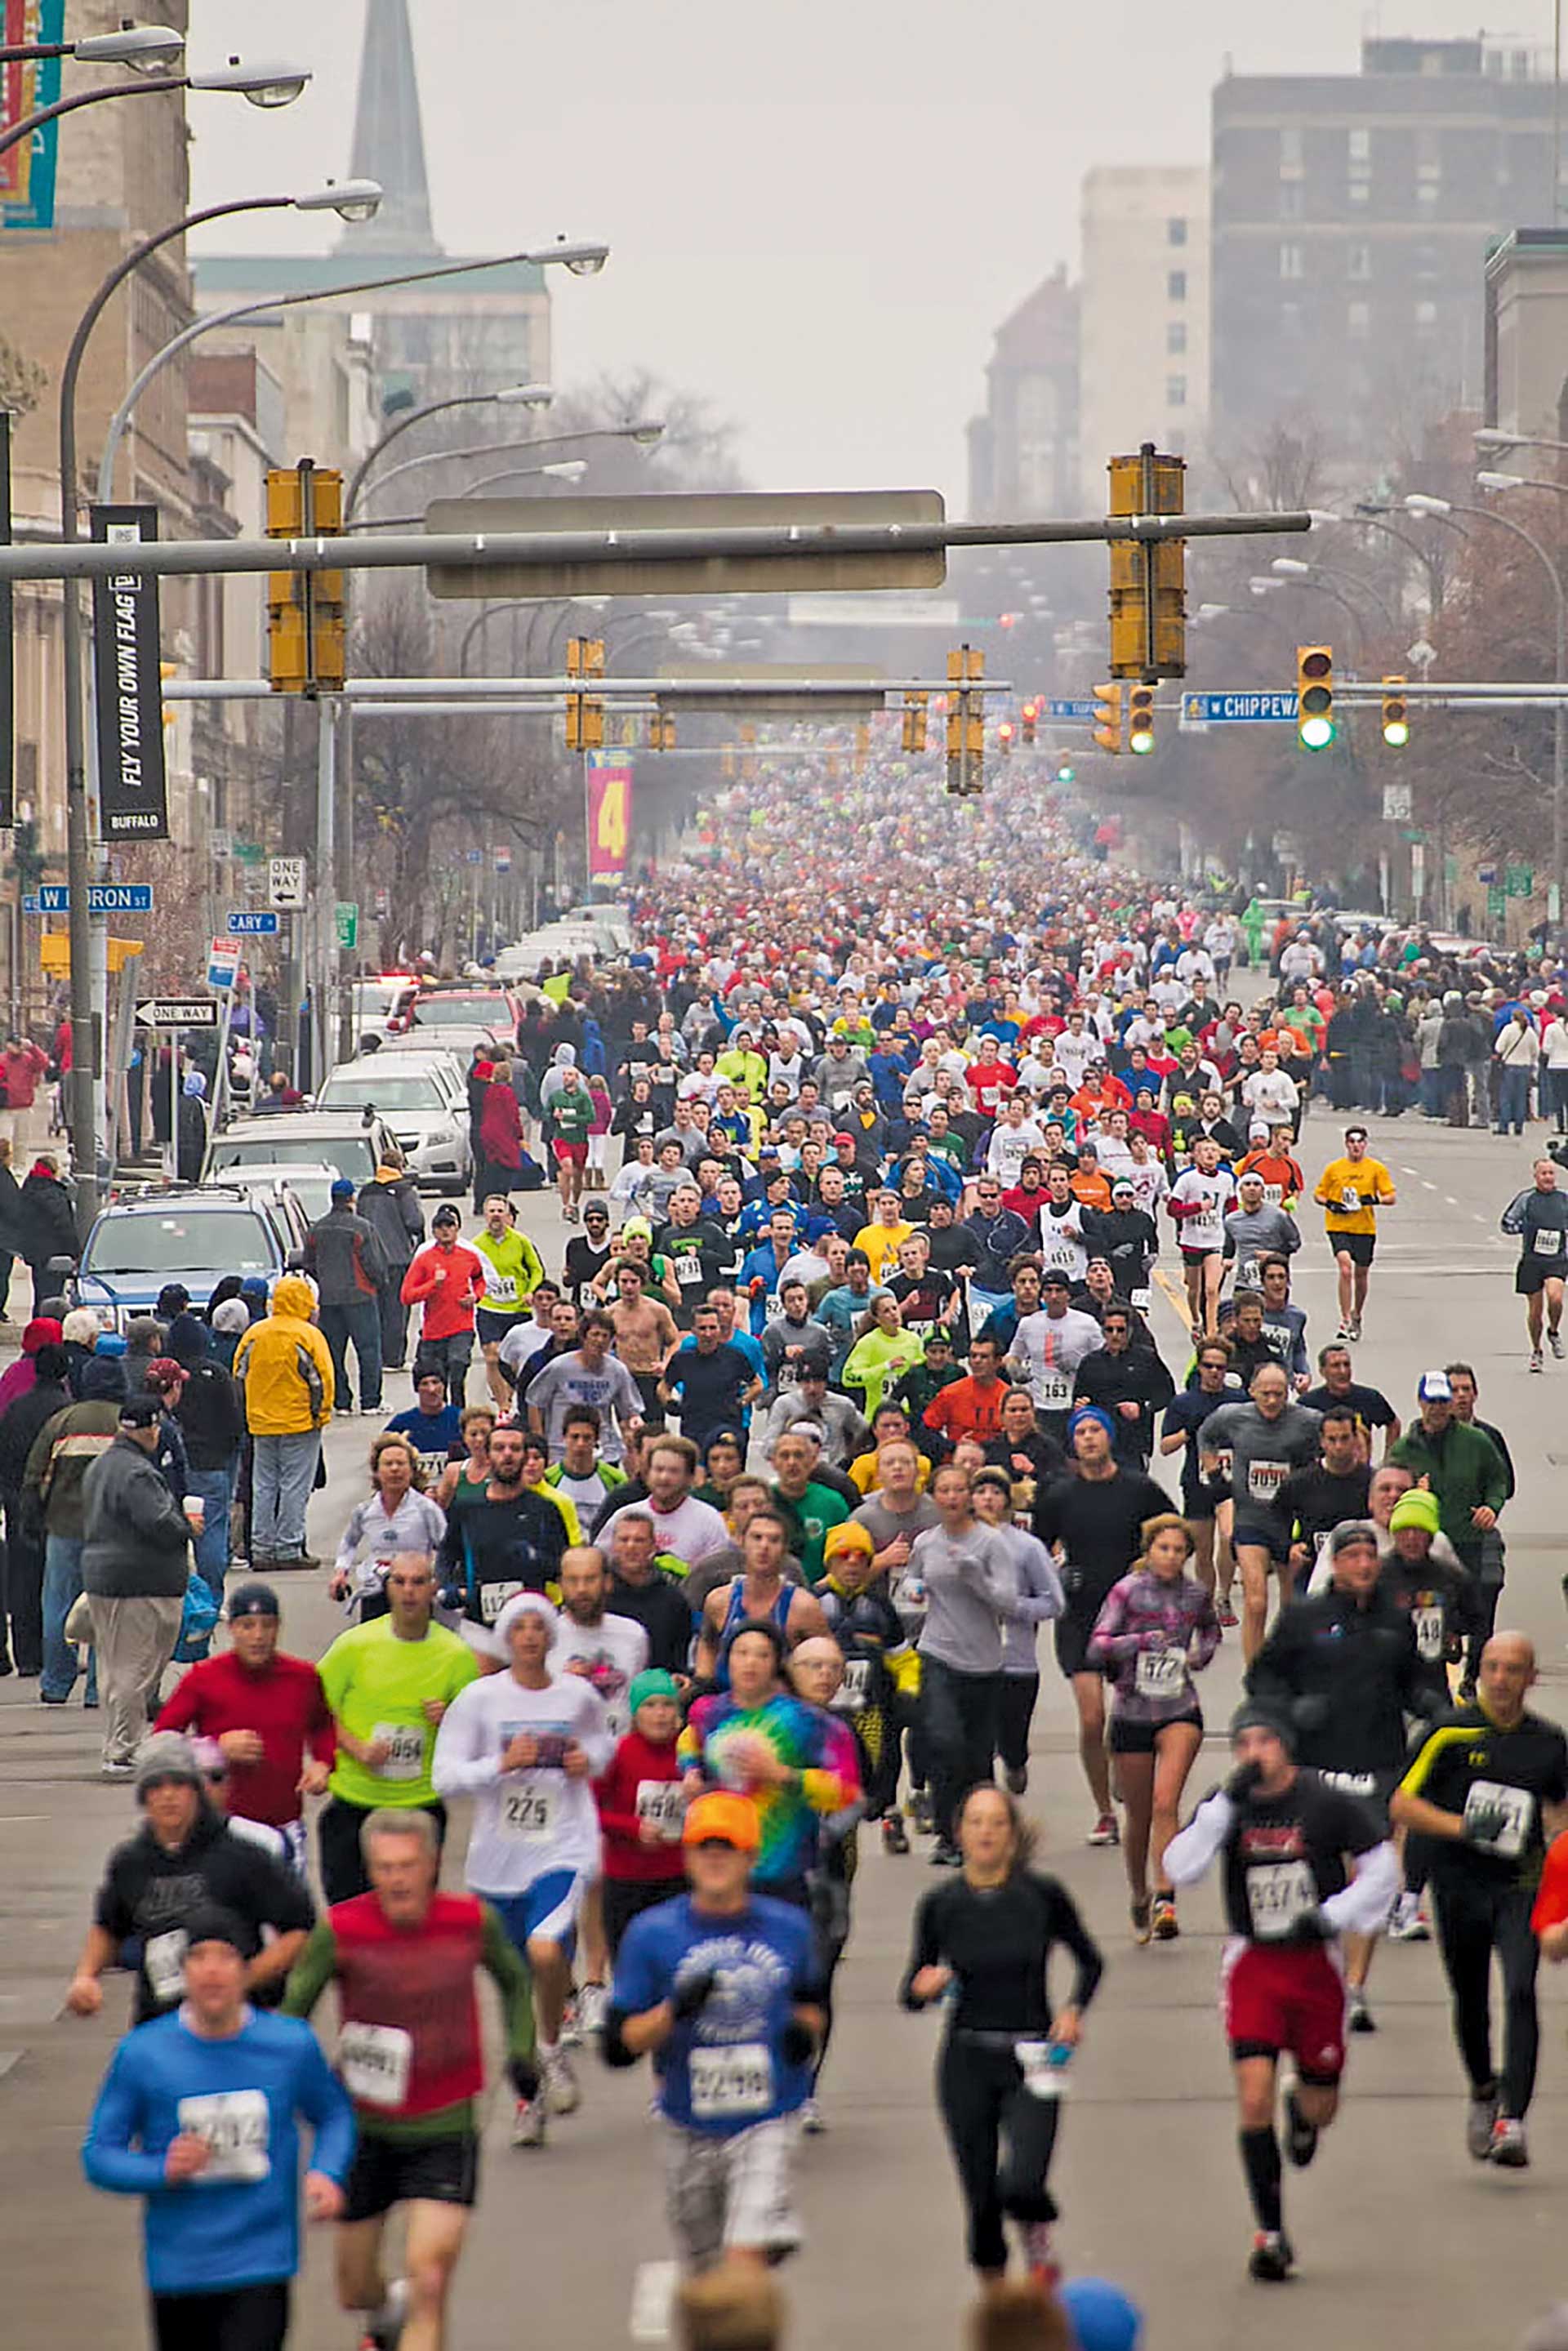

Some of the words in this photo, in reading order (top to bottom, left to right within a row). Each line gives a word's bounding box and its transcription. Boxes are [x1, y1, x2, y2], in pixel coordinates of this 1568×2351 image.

[115, 594, 136, 641] FLAG
[118, 643, 139, 692] OWN
[119, 697, 140, 746] YOUR
[121, 751, 142, 786] FLY
[111, 815, 158, 829] BUFFALO
[272, 862, 301, 873] ONE
[272, 876, 301, 888] WAY
[44, 888, 60, 907] W
[228, 916, 262, 929] CARY
[153, 1008, 179, 1018] ONE
[182, 1008, 208, 1018] WAY
[1045, 1384, 1067, 1398] 163
